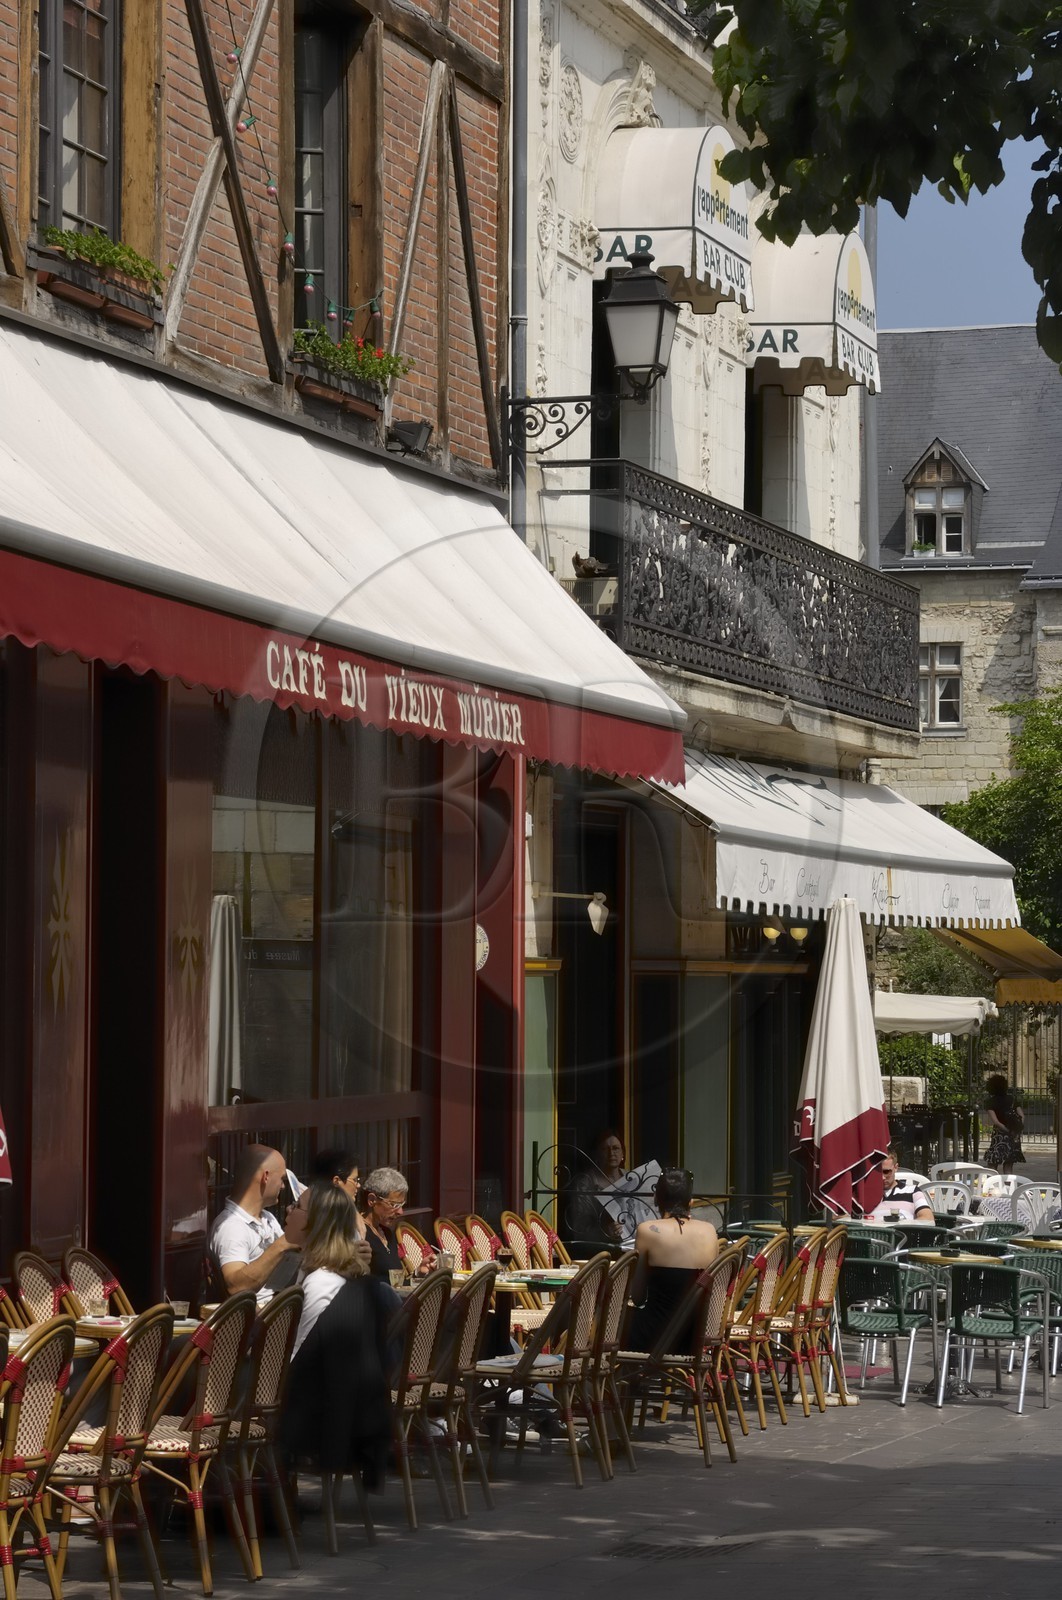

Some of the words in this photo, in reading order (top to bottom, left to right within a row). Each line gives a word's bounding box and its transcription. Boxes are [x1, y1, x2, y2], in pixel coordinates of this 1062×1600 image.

[697, 185, 749, 240] l'appartement
[703, 240, 721, 276] BAR
[724, 253, 746, 290] CLUB
[841, 333, 856, 365] BAR
[857, 345, 874, 376] CLUB
[266, 640, 327, 700] CAFÉ
[338, 660, 368, 713] DU
